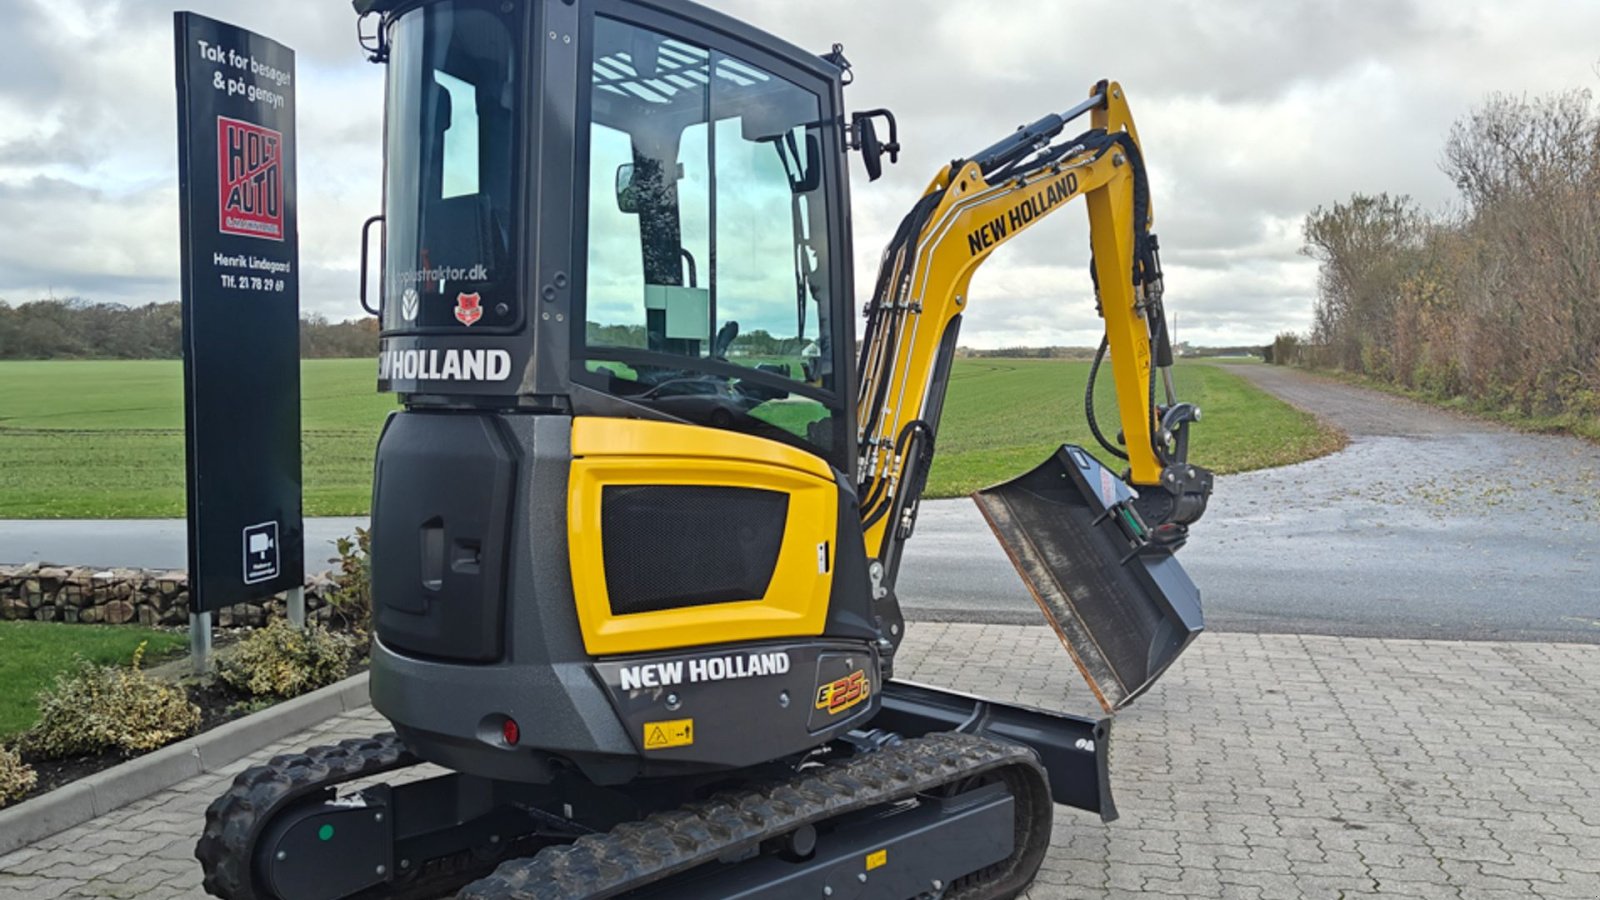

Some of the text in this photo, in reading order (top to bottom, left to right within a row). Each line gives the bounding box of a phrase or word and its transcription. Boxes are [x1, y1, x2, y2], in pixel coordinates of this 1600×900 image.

[198, 40, 226, 64] Tak
[229, 49, 248, 70] for
[213, 71, 284, 109] & på gensyn
[225, 159, 280, 219] AUTO
[967, 172, 1079, 256] NEW HOLLAND
[213, 252, 247, 268] Henrik
[239, 276, 249, 289] 21
[392, 349, 512, 381] HOLLAND
[620, 651, 790, 691] NEW HOLLAND
